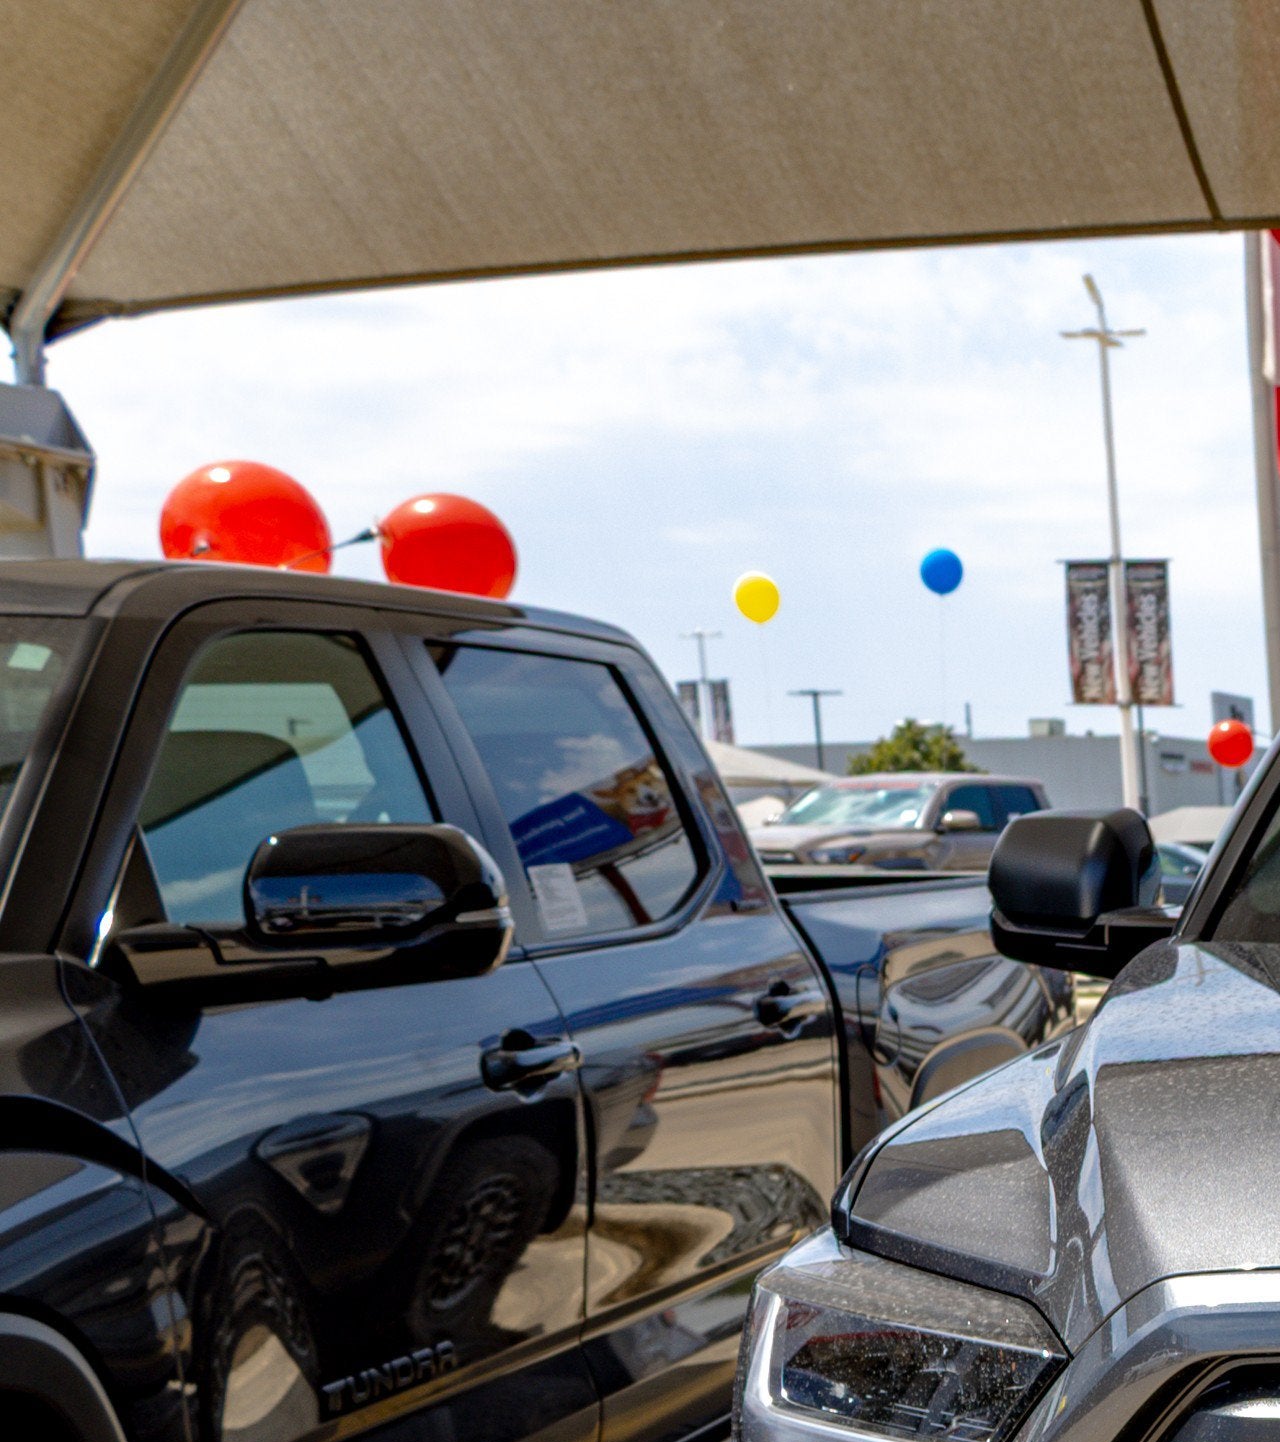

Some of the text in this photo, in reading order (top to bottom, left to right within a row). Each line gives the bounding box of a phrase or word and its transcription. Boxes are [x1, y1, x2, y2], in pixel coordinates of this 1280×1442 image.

[1076, 593, 1100, 659] Vehicles
[1135, 593, 1158, 659] Vehicles
[321, 1340, 459, 1412] TUNDRA
